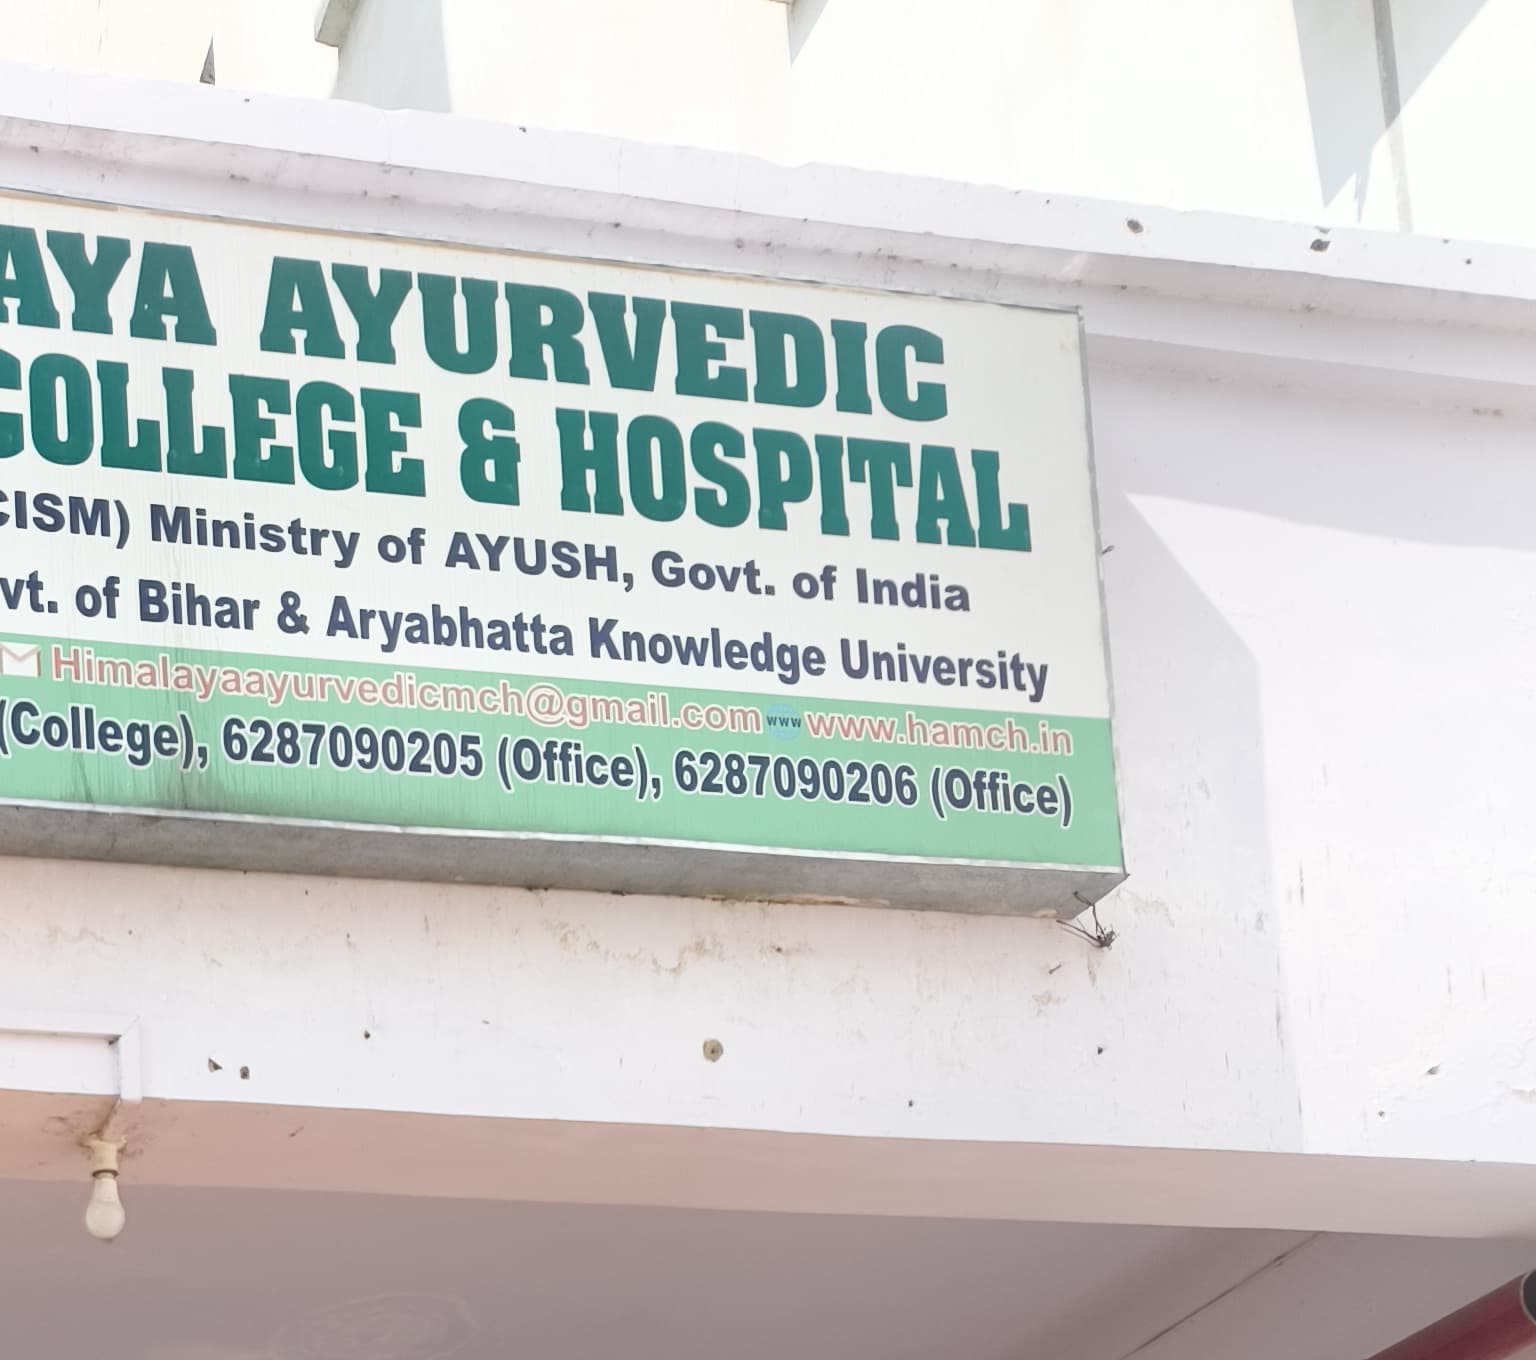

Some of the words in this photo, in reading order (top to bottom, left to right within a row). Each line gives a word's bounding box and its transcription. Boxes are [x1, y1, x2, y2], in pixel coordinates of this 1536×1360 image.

[260, 256, 949, 422] AYURVEDIC
[458, 397, 521, 507] &
[556, 407, 1032, 552] HOSPITAL
[150, 503, 360, 568] Ministry
[377, 528, 428, 566] of
[445, 532, 634, 592] AYUSH,
[651, 550, 775, 596] Govt.
[792, 565, 837, 600] of
[856, 568, 971, 612] India
[75, 575, 121, 618] of
[138, 578, 260, 631] Bihar
[277, 591, 310, 634] &
[326, 595, 574, 656] Aryabhatta
[588, 617, 826, 685] Knowledge
[840, 637, 1049, 703] University
[52, 647, 761, 732] Himalayaayurvedicmch@gmail.com
[806, 711, 1073, 755] www.hamch.in
[222, 717, 483, 777] 6287090205
[498, 737, 662, 800] (Office),
[674, 750, 917, 806] 6287090206
[931, 766, 1073, 827] (Office)
